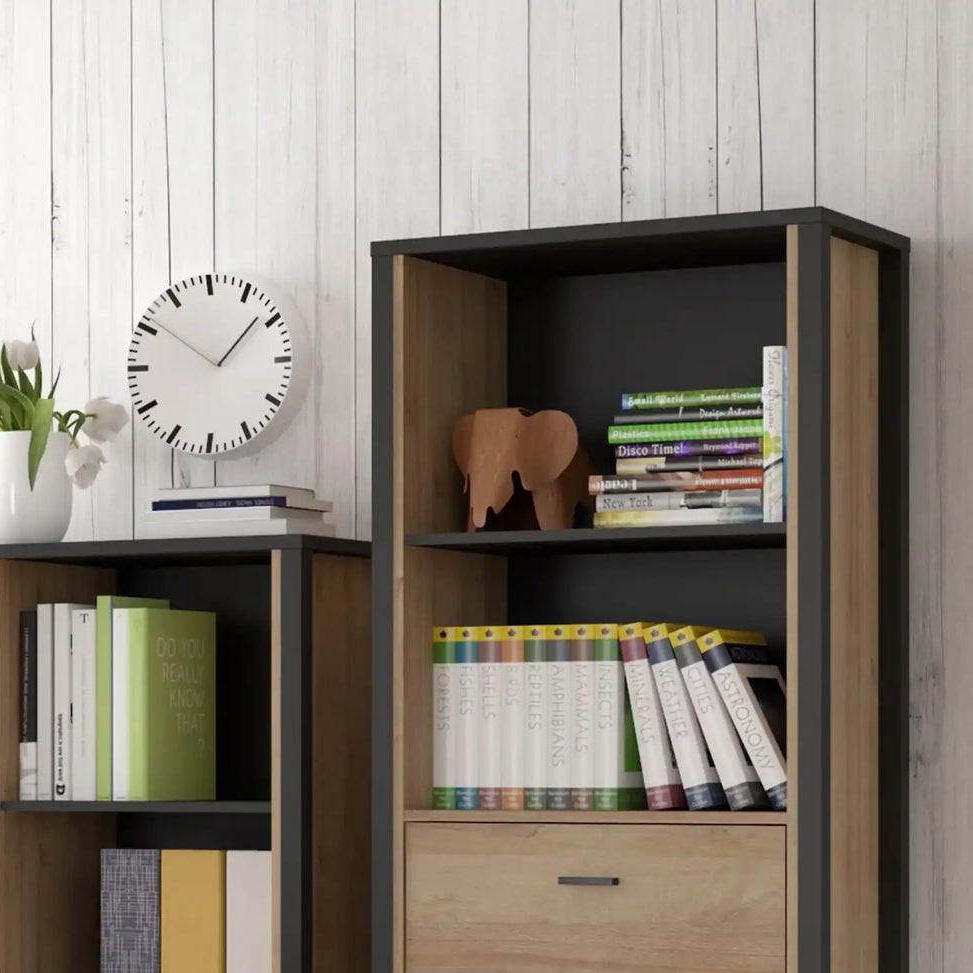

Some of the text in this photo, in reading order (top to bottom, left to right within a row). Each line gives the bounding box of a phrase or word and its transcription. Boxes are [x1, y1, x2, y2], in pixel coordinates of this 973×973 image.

[627, 393, 684, 408] Small World
[699, 407, 726, 420] Design
[618, 442, 684, 457] Disco Time!
[602, 496, 654, 509] New York
[156, 636, 205, 660] DO YOU
[162, 662, 205, 684] REALLY
[459, 665, 473, 716] FISHES
[482, 665, 496, 720] SHELLS
[505, 665, 519, 707] BRDS
[598, 664, 613, 730] INSECTS
[685, 667, 715, 715] CITIES
[169, 687, 205, 709] KNOW
[528, 664, 543, 731] REPTILES
[551, 664, 566, 769] AMPHIBIANS
[574, 664, 589, 754] MAMMALS
[629, 664, 655, 744] MINERALS
[658, 663, 689, 738] WEATHER
[717, 671, 775, 769] ASTRONOMY
[174, 712, 206, 735] THAT
